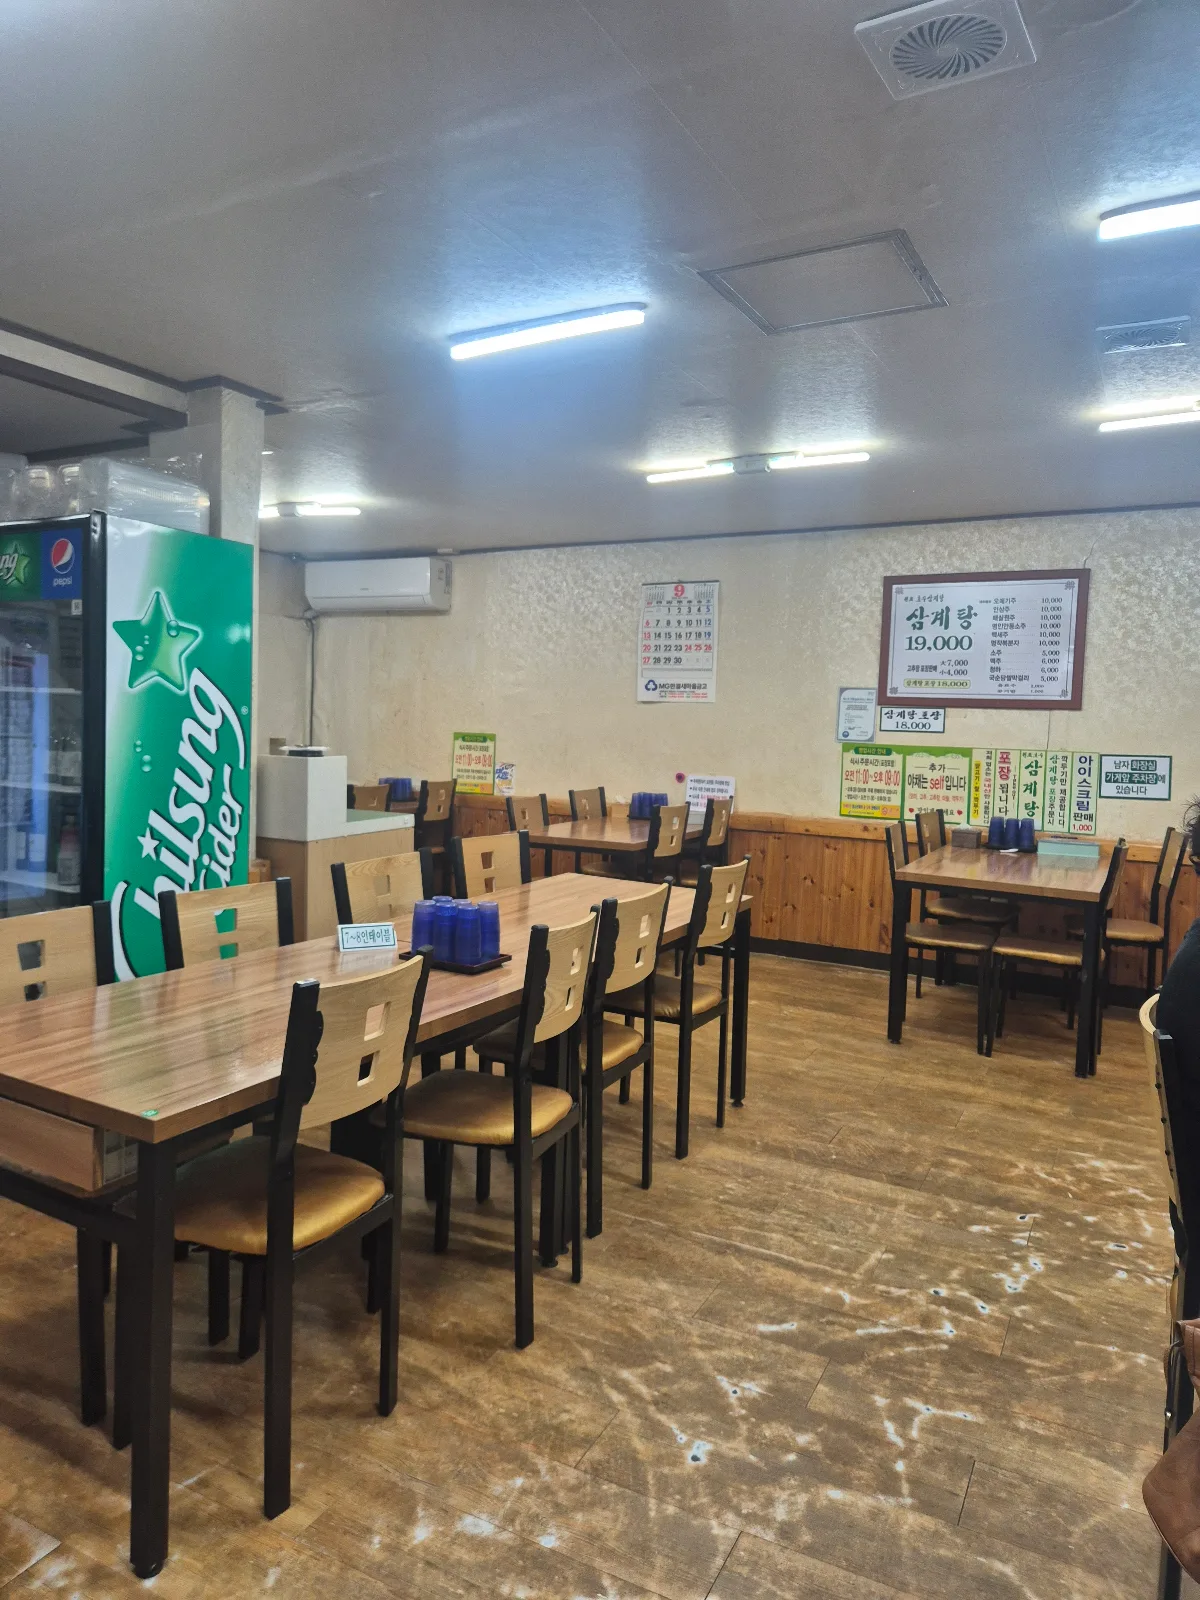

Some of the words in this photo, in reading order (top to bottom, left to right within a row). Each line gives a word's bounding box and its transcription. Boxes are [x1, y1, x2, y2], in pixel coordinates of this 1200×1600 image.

[53, 576, 73, 587] pepsi
[674, 584, 685, 597] 9
[906, 605, 978, 630] 삼계탕
[905, 635, 973, 652] 19,000
[884, 709, 917, 720] 삼계탕
[918, 710, 942, 720] 포장
[929, 763, 945, 773] 추가
[998, 751, 1011, 781] 포장
[1049, 755, 1060, 785] 삼계탕
[1114, 760, 1129, 769] 남자
[1131, 760, 1156, 770] 화장실
[845, 770, 854, 781] 오전
[873, 772, 883, 783] 오후
[1076, 755, 1093, 811] 아이스크림
[1106, 773, 1130, 783] 가게앞
[1132, 774, 1166, 784] 주차장에
[1023, 760, 1042, 817] 삼계탕
[1116, 785, 1147, 795] 있습니다
[998, 783, 1009, 816] 됩니다
[1073, 813, 1093, 822] 판매
[199, 763, 243, 890] ider
